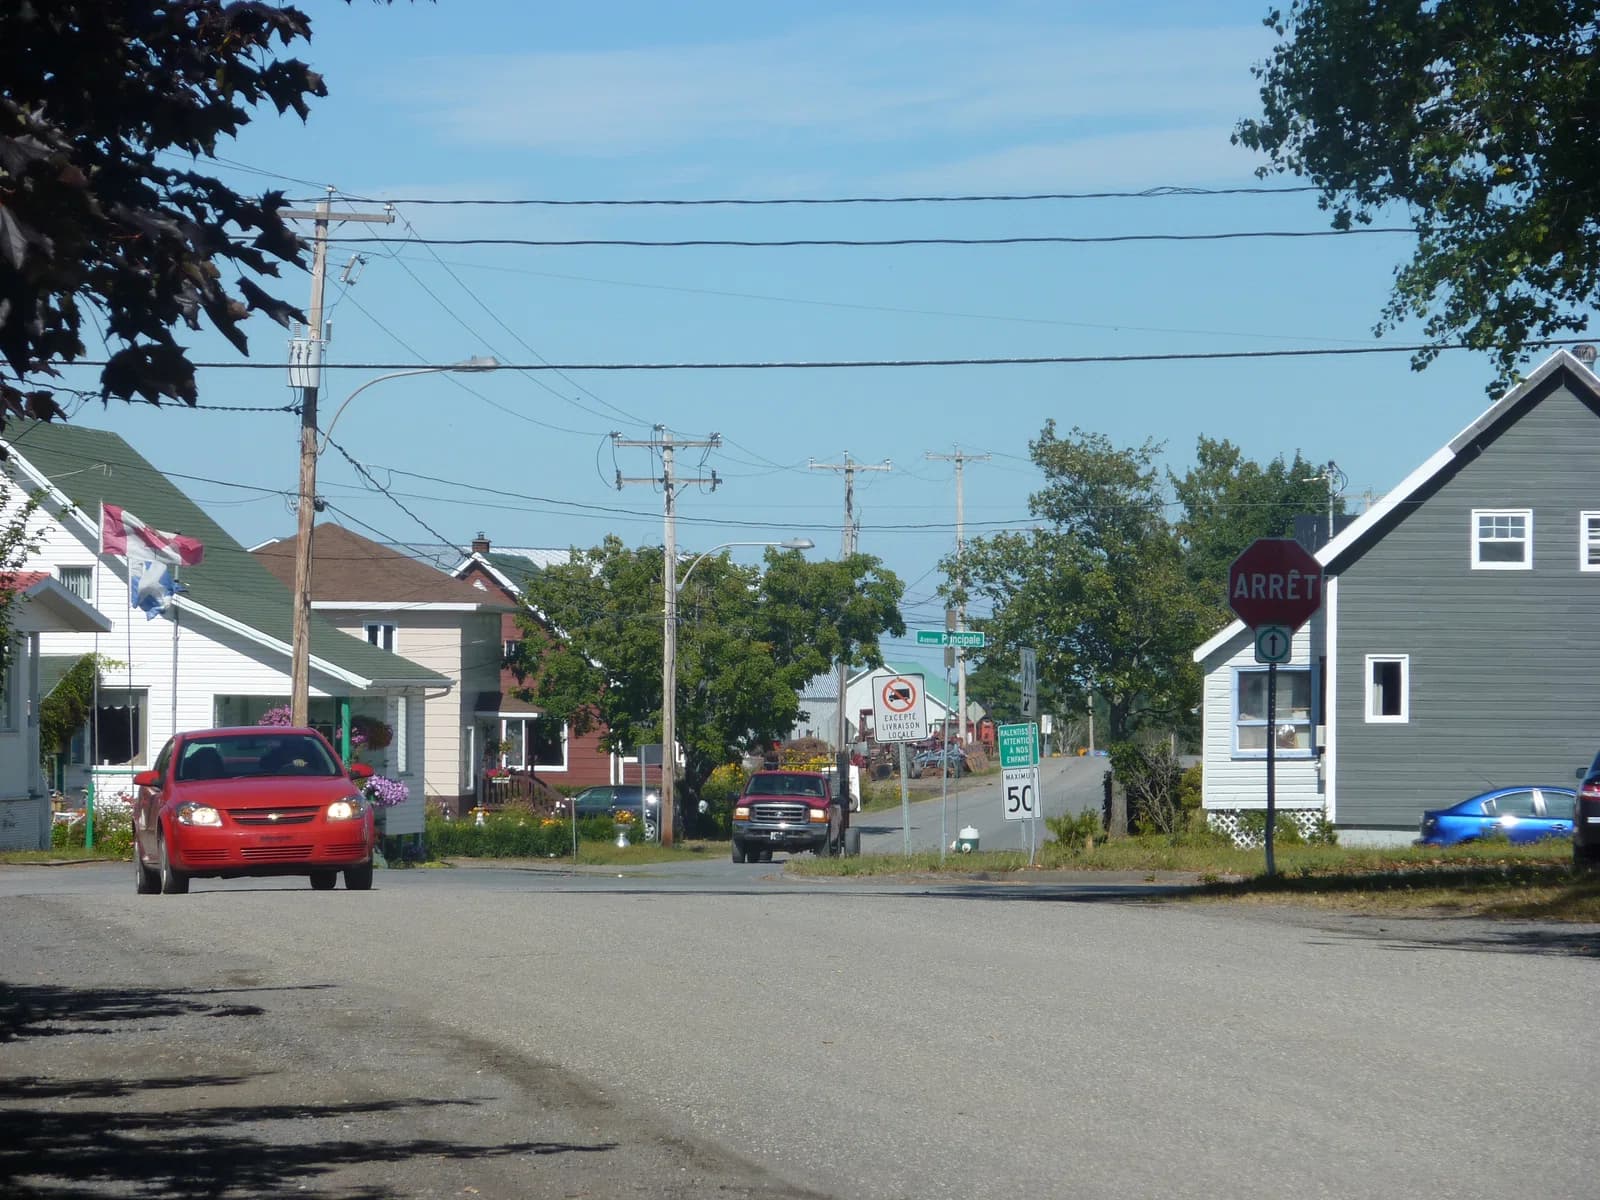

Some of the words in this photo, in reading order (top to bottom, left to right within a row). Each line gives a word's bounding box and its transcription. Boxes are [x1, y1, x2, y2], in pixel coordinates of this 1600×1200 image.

[1233, 569, 1317, 600] ARRÊT
[941, 633, 981, 646] Pincipale
[882, 721, 920, 731] LIVRAISON
[888, 730, 916, 739] LOCALE
[1000, 727, 1036, 737] RALENTISSZ
[1015, 745, 1029, 754] NOS
[1006, 755, 1029, 764] ENFANT
[1007, 784, 1032, 813] 50
